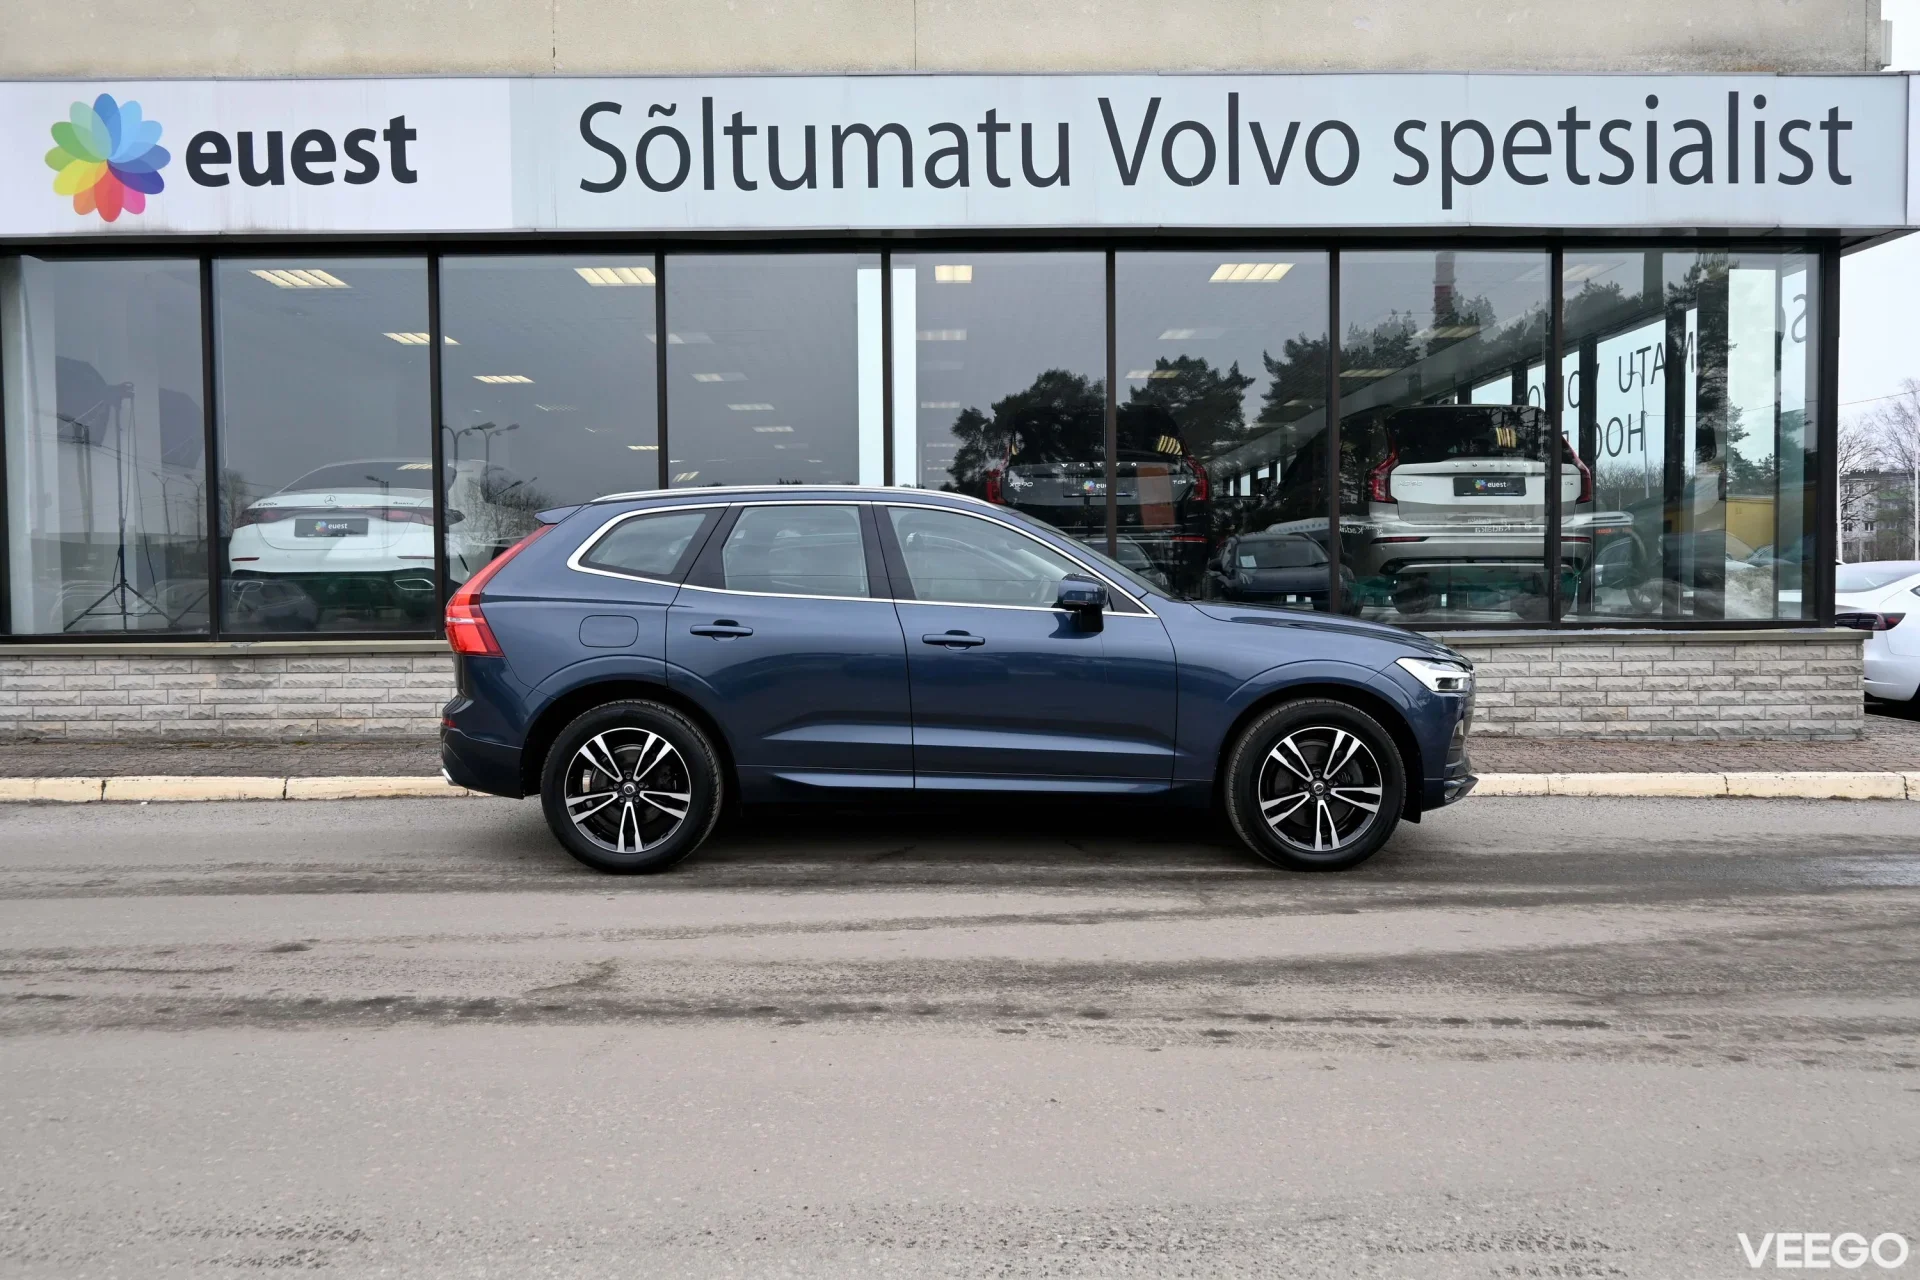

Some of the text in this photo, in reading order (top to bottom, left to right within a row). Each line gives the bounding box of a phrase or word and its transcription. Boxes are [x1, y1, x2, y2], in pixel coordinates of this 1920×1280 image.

[186, 115, 418, 188] euest
[579, 91, 1853, 210] Sõltumatu Volvo spetsialist
